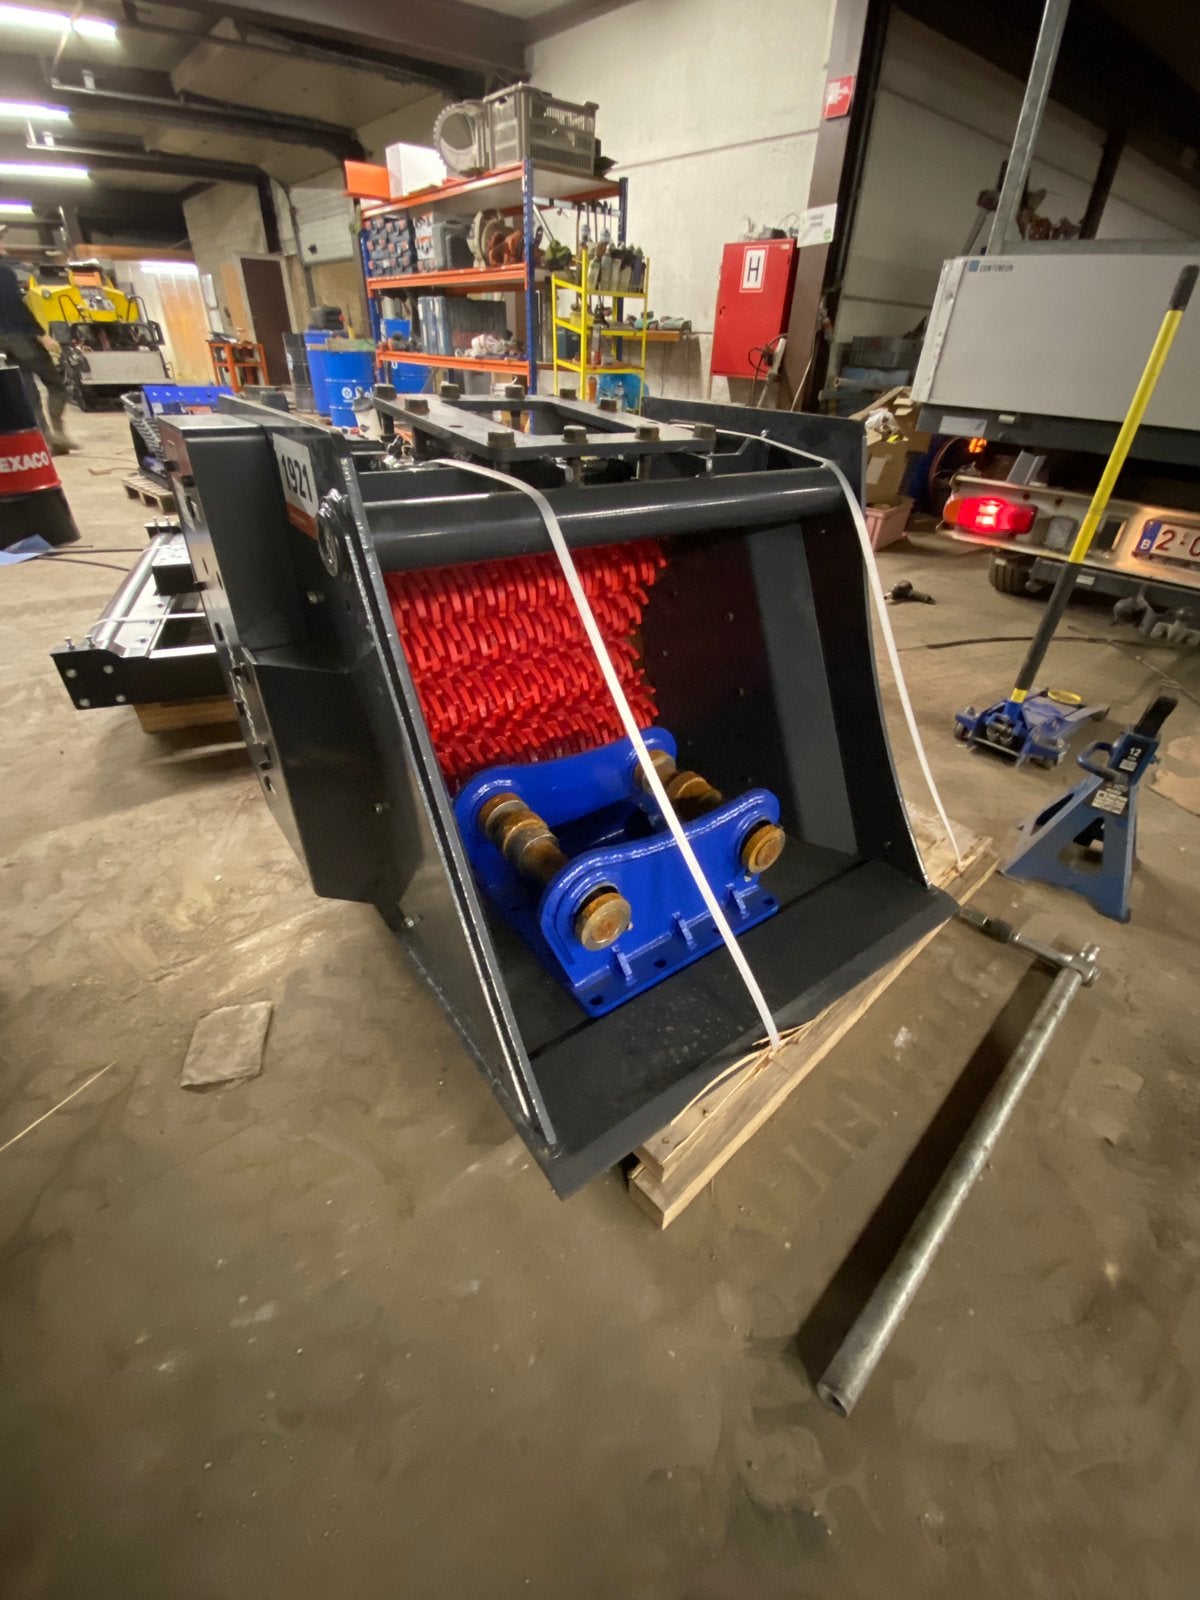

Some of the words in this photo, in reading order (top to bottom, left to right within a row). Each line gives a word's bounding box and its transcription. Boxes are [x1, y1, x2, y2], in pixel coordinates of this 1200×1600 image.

[746, 255, 762, 282] H
[281, 454, 313, 502] 1921
[1129, 747, 1142, 757] 12
